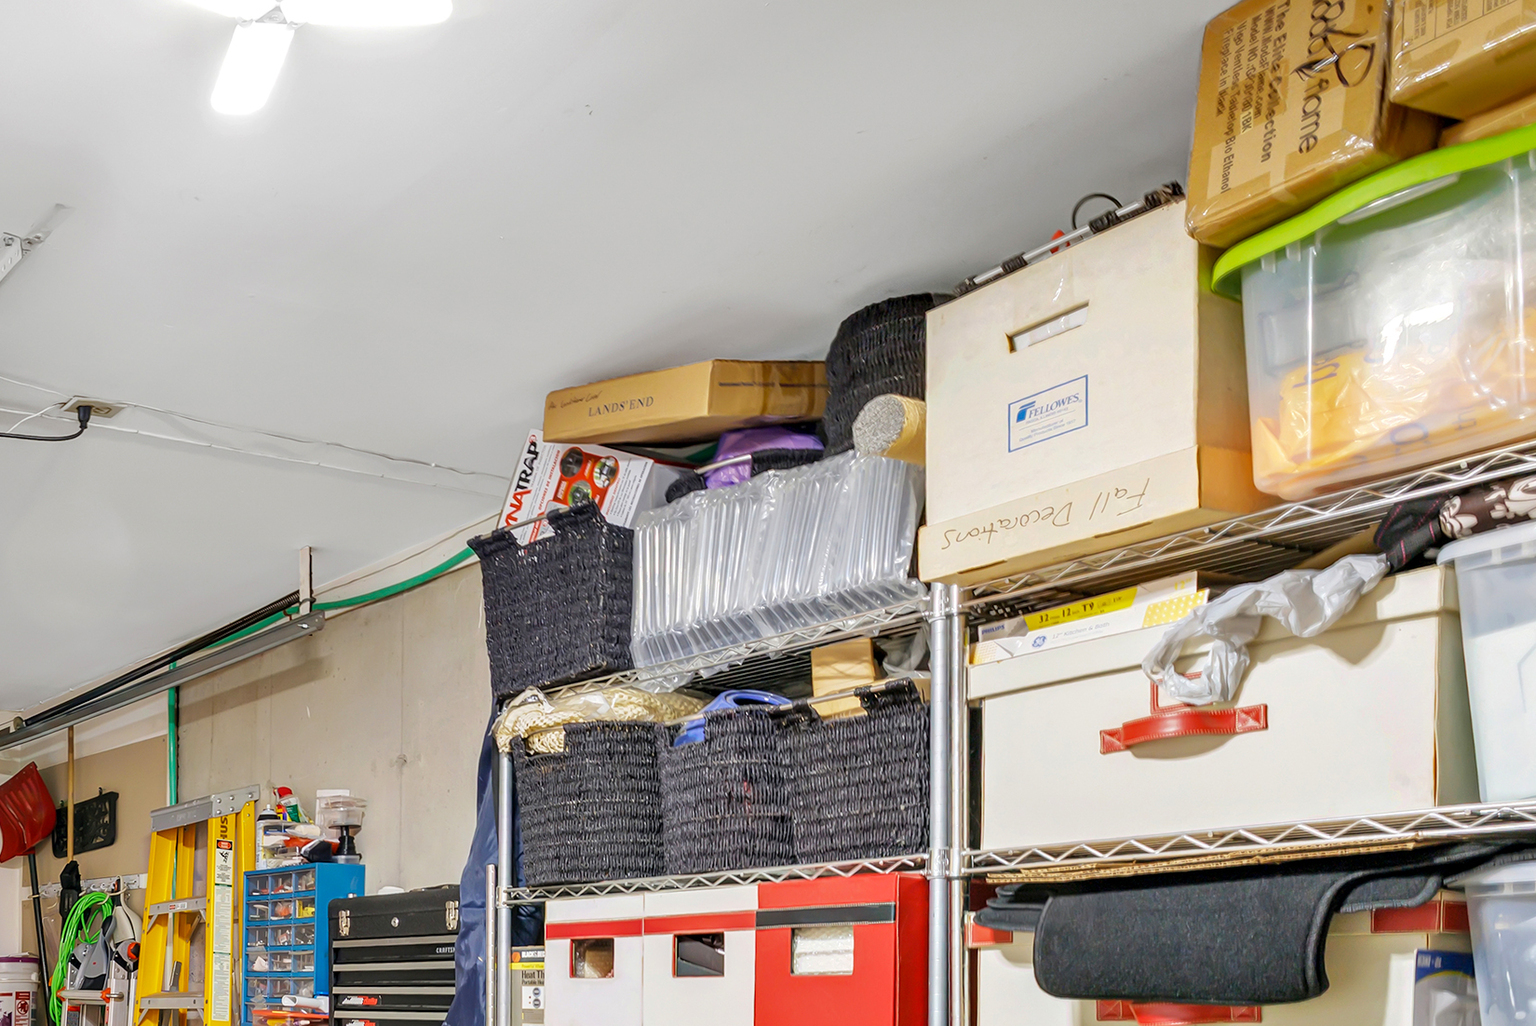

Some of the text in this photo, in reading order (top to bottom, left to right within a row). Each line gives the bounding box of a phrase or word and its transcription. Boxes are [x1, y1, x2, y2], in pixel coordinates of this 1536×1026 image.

[1249, 14, 1263, 46] Model
[1275, 0, 1292, 32] The
[1220, 28, 1234, 77] Fireplace
[1271, 33, 1288, 73] Elite
[1219, 75, 1229, 88] in
[1221, 20, 1247, 194] Vigo Ventless Tabletop Bio Ethanol
[588, 396, 654, 417] LANDS'END
[1028, 392, 1079, 419] FELLOWES
[505, 440, 539, 526] YNATRAP
[942, 478, 1150, 550] Fall Decorations
[982, 624, 1005, 636] PHILIPS
[1039, 613, 1049, 624] 32
[1062, 608, 1071, 618] 12
[220, 815, 228, 839] HUS
[522, 970, 545, 979] Heat Th
